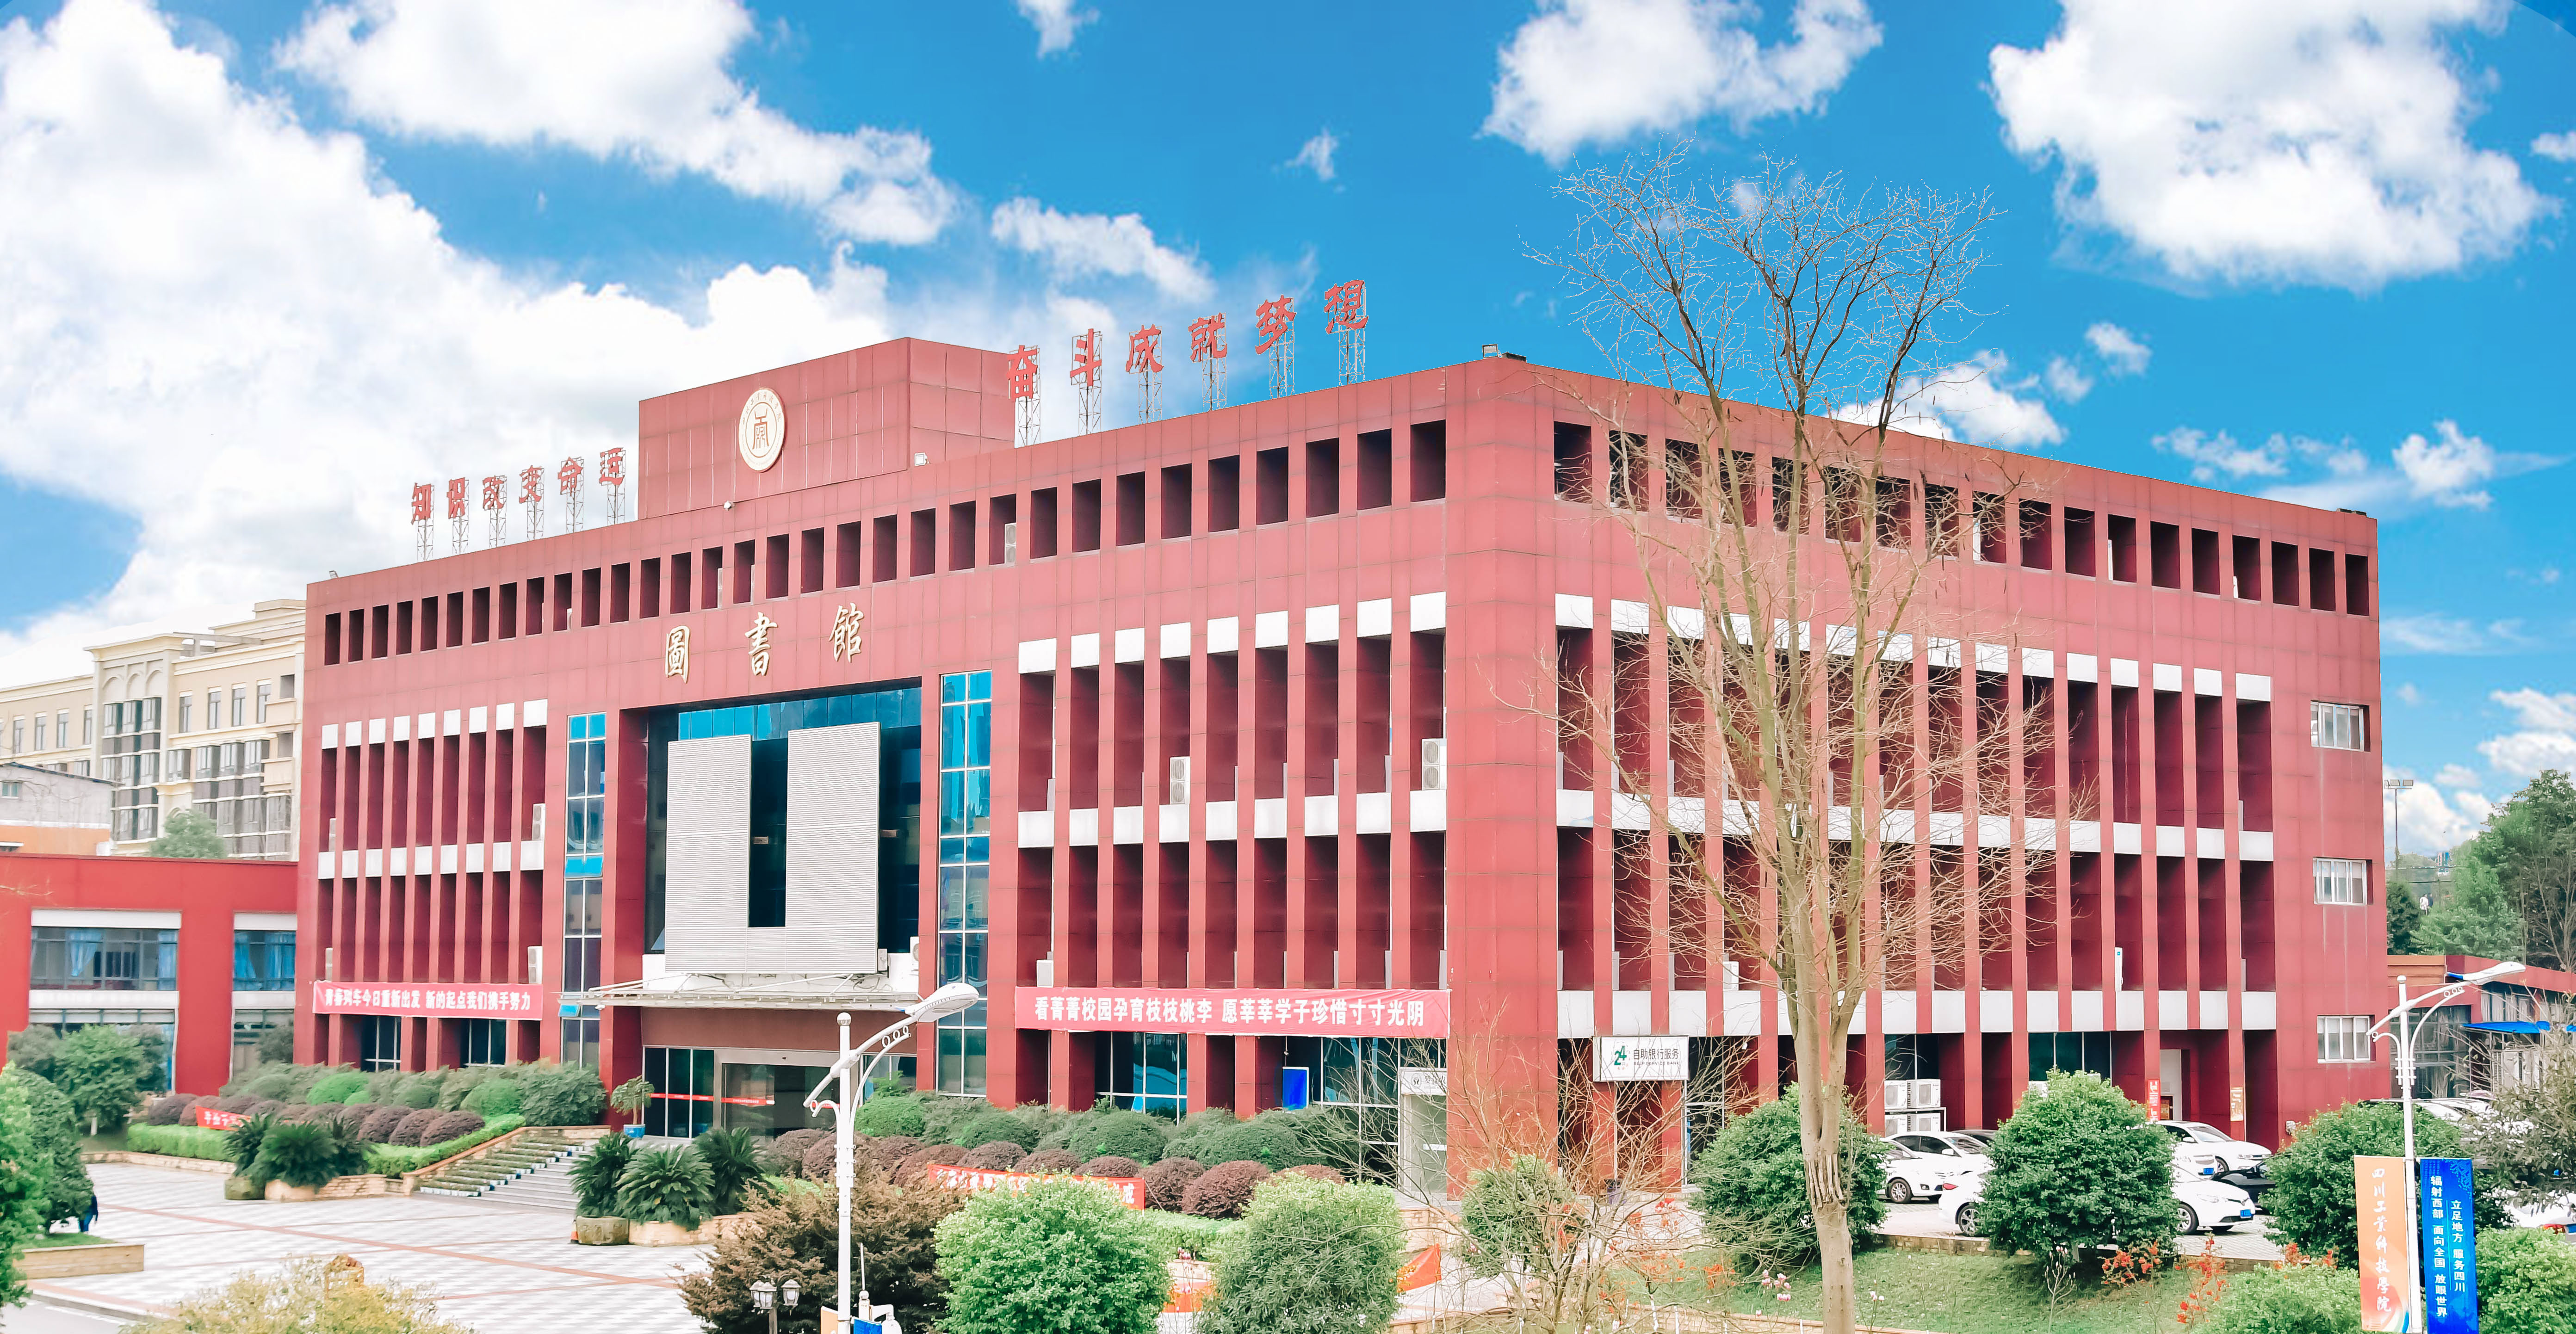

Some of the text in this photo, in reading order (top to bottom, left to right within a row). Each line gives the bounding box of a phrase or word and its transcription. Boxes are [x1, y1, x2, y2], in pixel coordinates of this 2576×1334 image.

[1006, 279, 1369, 401] 奋斗成就梦想
[411, 447, 625, 525] 知识改变命运
[665, 602, 864, 684] 圖書館
[325, 988, 531, 1010] 青春列车今日重新出发 新的起点我们携手努力
[1035, 996, 1424, 1026] 看菁菁校园孕育枝枝桃李 愿莘莘学子珍惜寸寸光阴
[1634, 1048, 1679, 1060] 自助银行服务
[2431, 1176, 2448, 1317] 辐射西部 面向全国 放眼世界
[2451, 1200, 2465, 1292] 立足地方 服务四川
